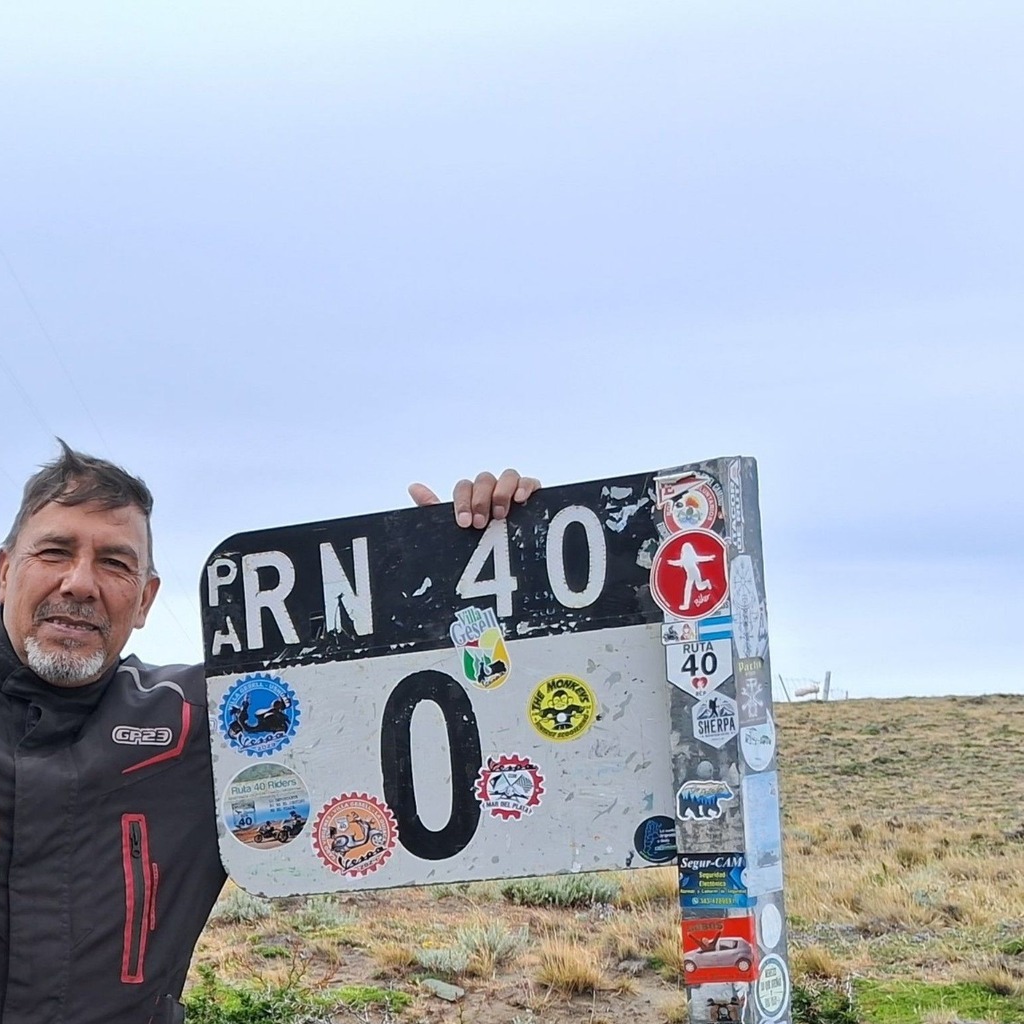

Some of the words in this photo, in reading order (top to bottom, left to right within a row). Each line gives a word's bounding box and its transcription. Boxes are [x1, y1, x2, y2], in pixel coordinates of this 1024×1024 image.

[456, 504, 606, 618] 40
[457, 608, 482, 625] Villa
[451, 610, 496, 645] Gesell
[683, 642, 714, 654] RUTA
[681, 651, 718, 676] 40
[532, 690, 545, 711] THE
[546, 679, 590, 703] MONKEYS
[698, 716, 736, 735] SHERPA
[116, 728, 169, 742] GP23
[381, 670, 483, 861] 0
[231, 786, 252, 796] Ruta
[254, 782, 266, 791] 40
[268, 778, 297, 788] Riders
[239, 816, 253, 826] 40
[680, 856, 743, 870] Segur-CAM
